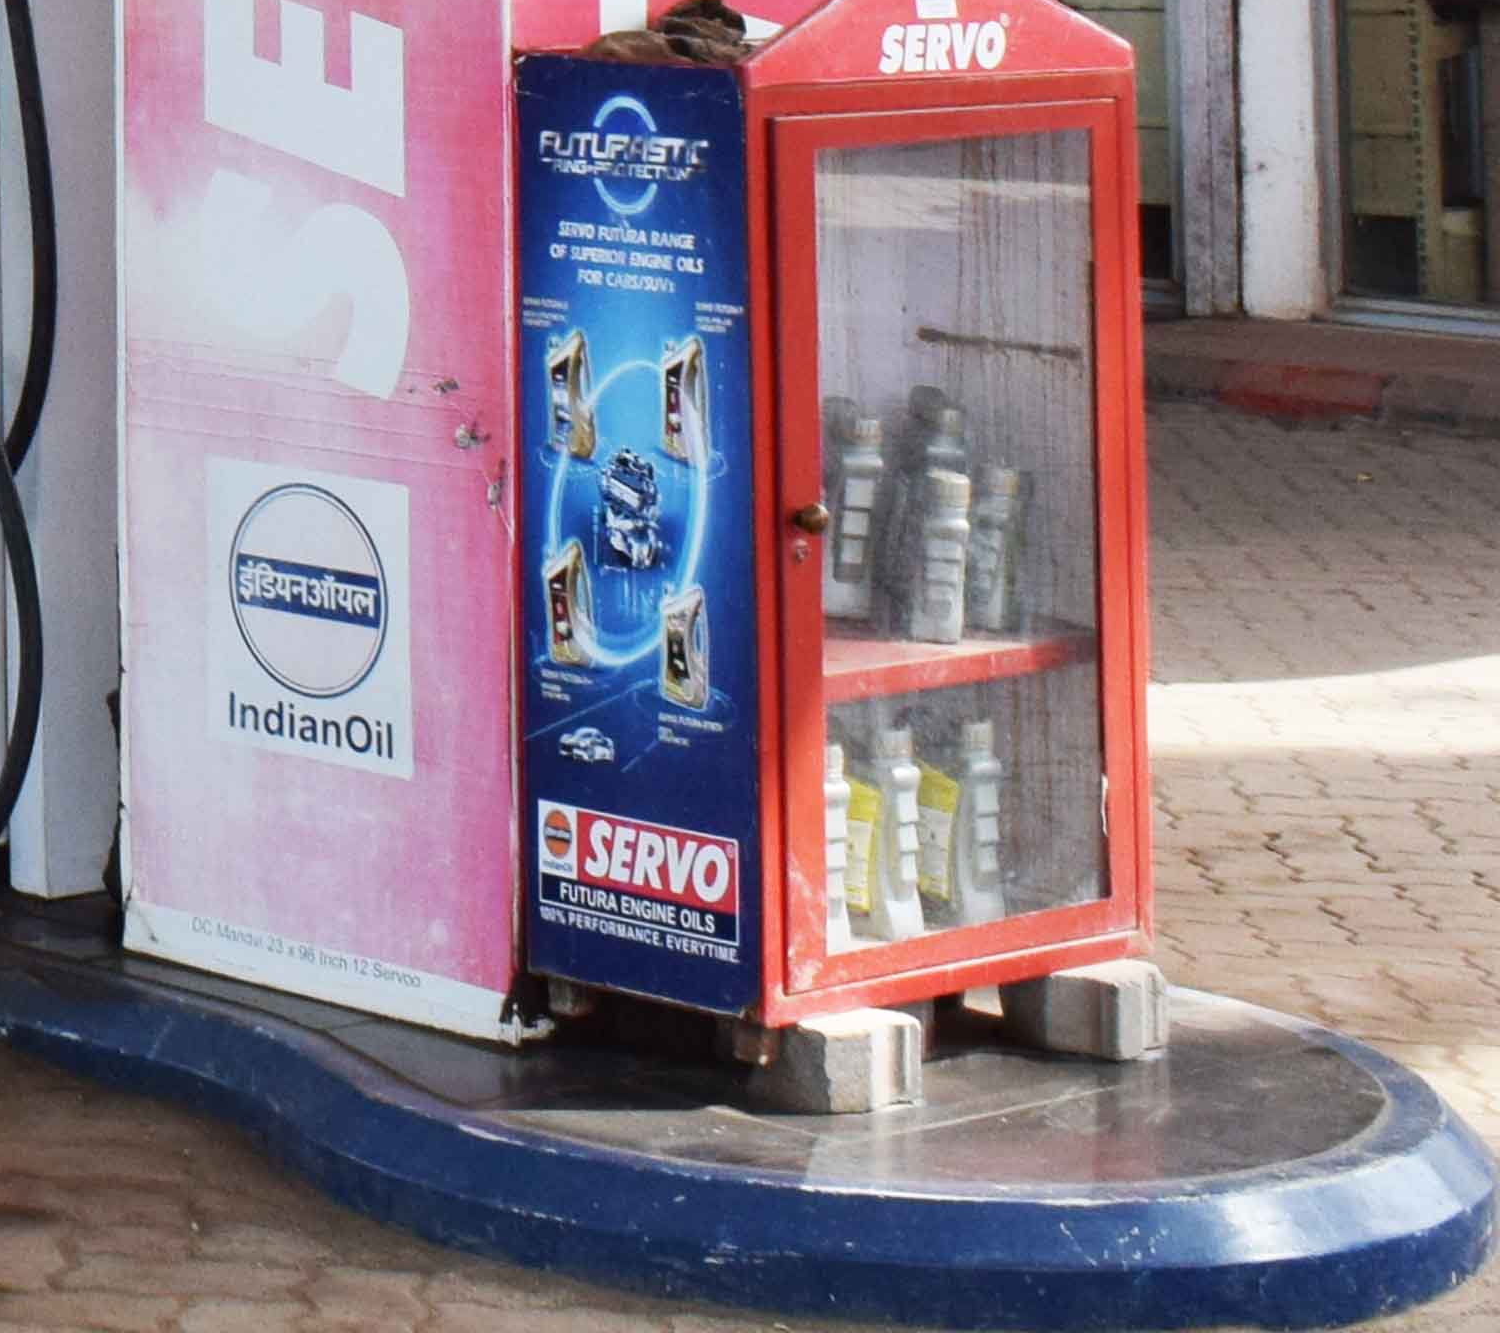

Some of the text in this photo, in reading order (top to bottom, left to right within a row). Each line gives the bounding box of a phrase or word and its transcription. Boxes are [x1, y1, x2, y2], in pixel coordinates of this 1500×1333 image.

[878, 21, 1007, 75] SERVO
[549, 243, 705, 275] OF SUPERIOR ENGINE OILS
[558, 220, 696, 251] SERVO FUTURA RANGE
[577, 268, 603, 284] FOR
[238, 554, 378, 622] इंडियनऑयल
[228, 688, 394, 762] IndianOil
[583, 818, 730, 904] SERVO
[539, 905, 567, 926] 100%
[559, 881, 716, 935] FUTURA ENGINE OILS
[191, 916, 213, 935] DC
[319, 949, 348, 972] Inch
[353, 957, 370, 976] 12
